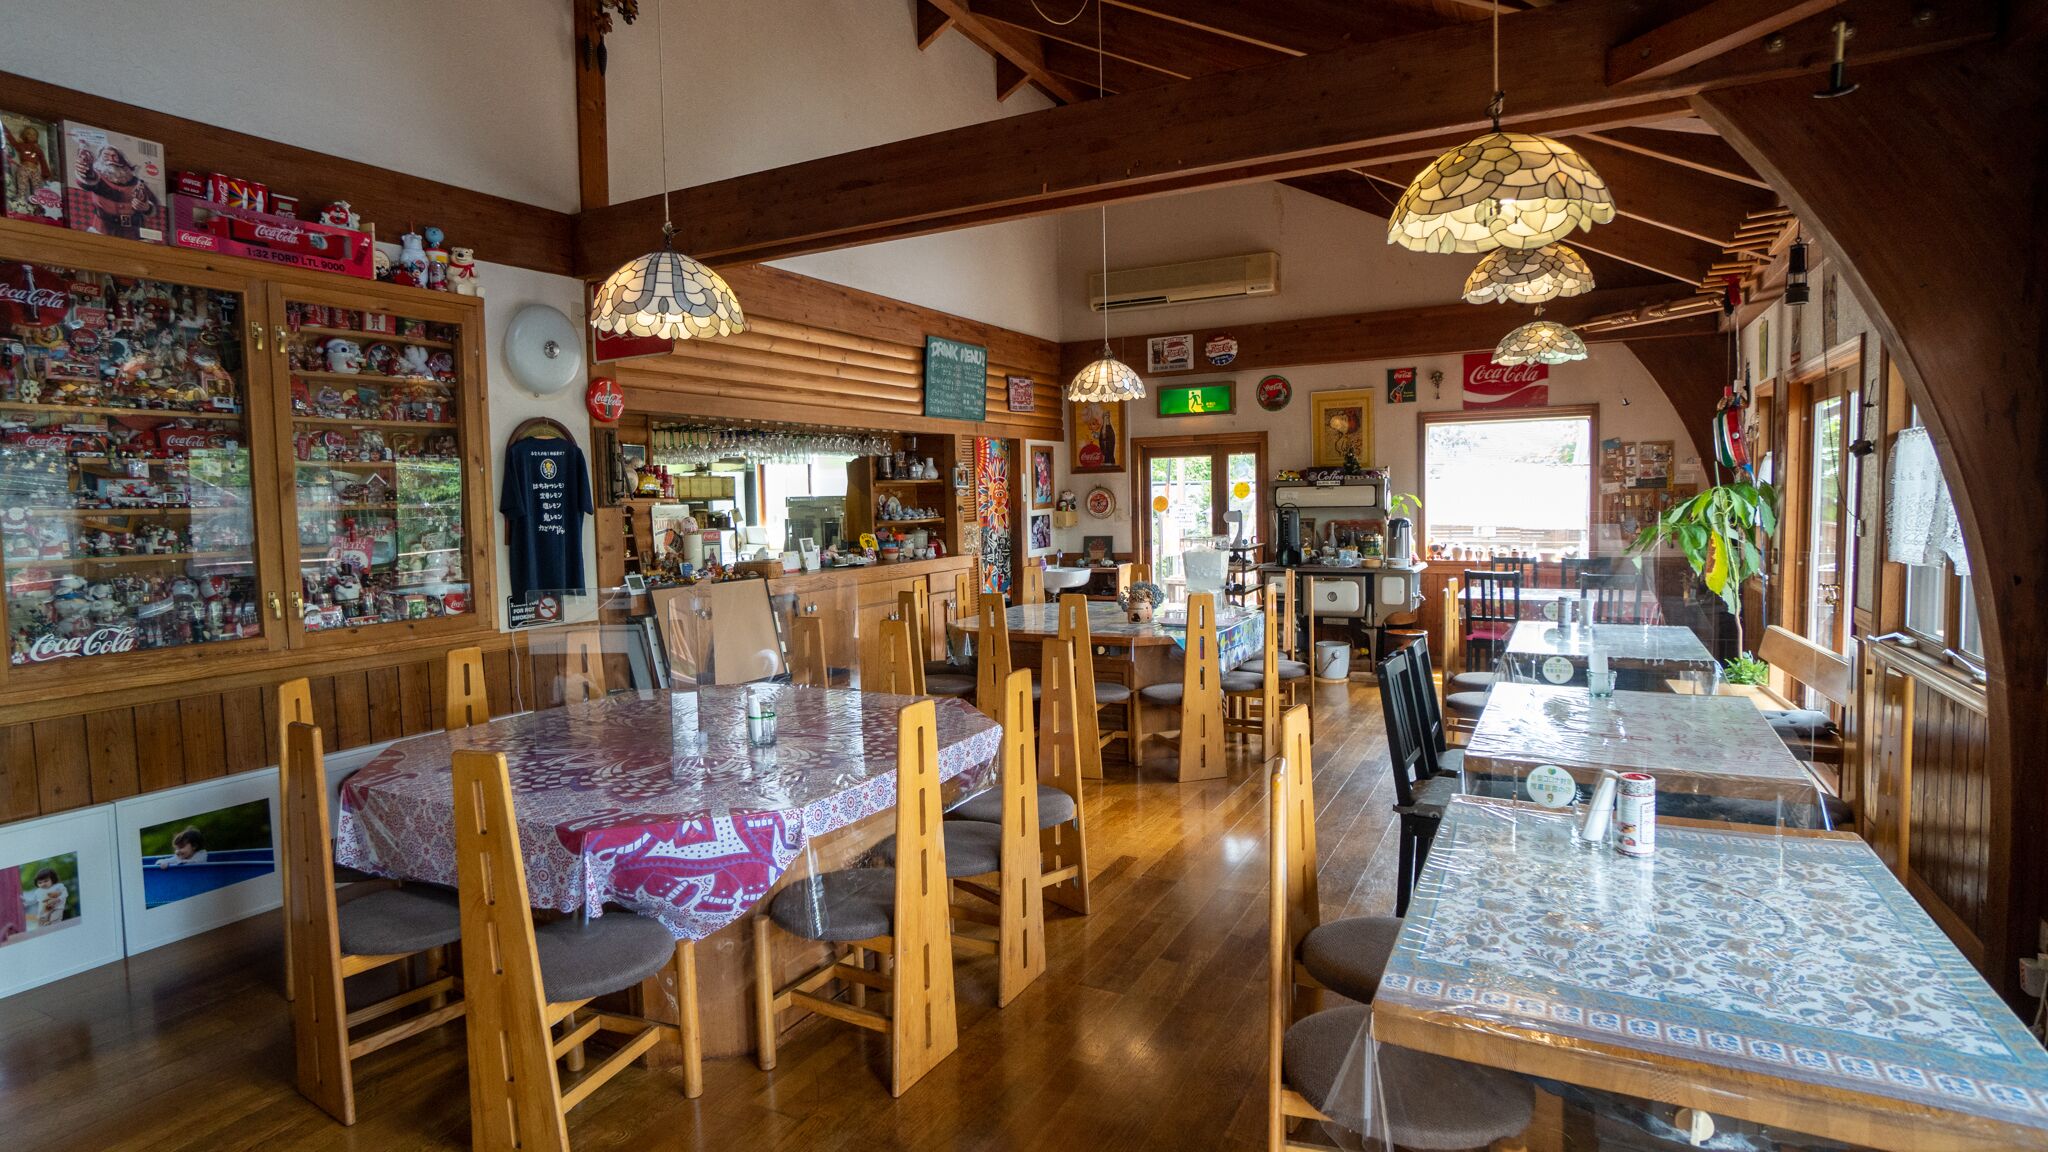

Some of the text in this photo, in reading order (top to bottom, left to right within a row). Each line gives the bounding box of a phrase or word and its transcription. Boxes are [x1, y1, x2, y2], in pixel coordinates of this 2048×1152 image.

[181, 232, 213, 246] Coca-Cola
[254, 224, 300, 244] Coca-Cola
[246, 247, 346, 272] 1:32 FORD LTL 9000
[930, 341, 958, 362] DRINK
[1469, 363, 1540, 385] Coca-Cola
[594, 391, 623, 406] Coca-Cola
[167, 434, 205, 447] Coca-Cola
[1317, 470, 1344, 481] Coffee
[30, 626, 137, 662] Coca-Cola
